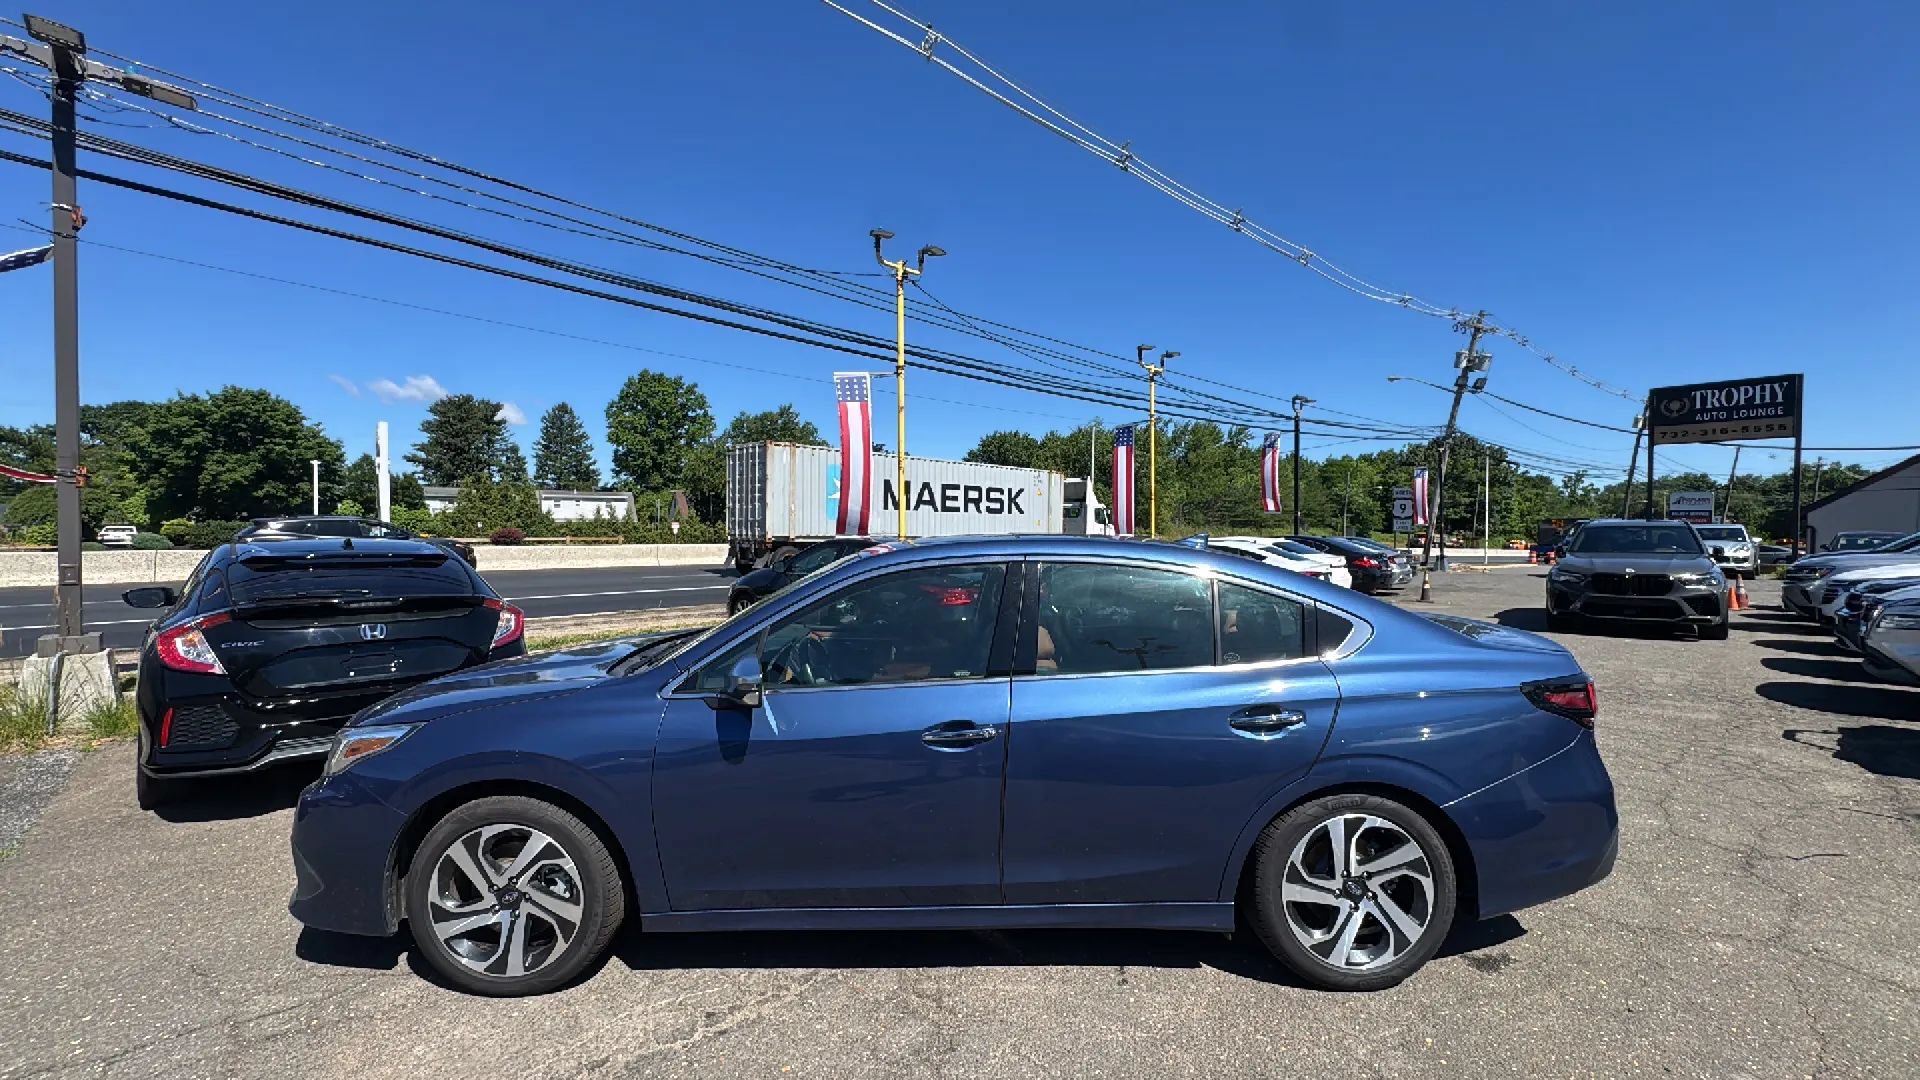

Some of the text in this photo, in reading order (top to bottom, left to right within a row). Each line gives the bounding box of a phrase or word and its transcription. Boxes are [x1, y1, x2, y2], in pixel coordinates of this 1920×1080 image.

[1691, 381, 1788, 409] TROPHY
[1695, 406, 1784, 421] AUTO LOUNGE
[883, 479, 1025, 514] MAERSK
[1399, 503, 1407, 514] 9
[221, 640, 265, 648] CIVIC
